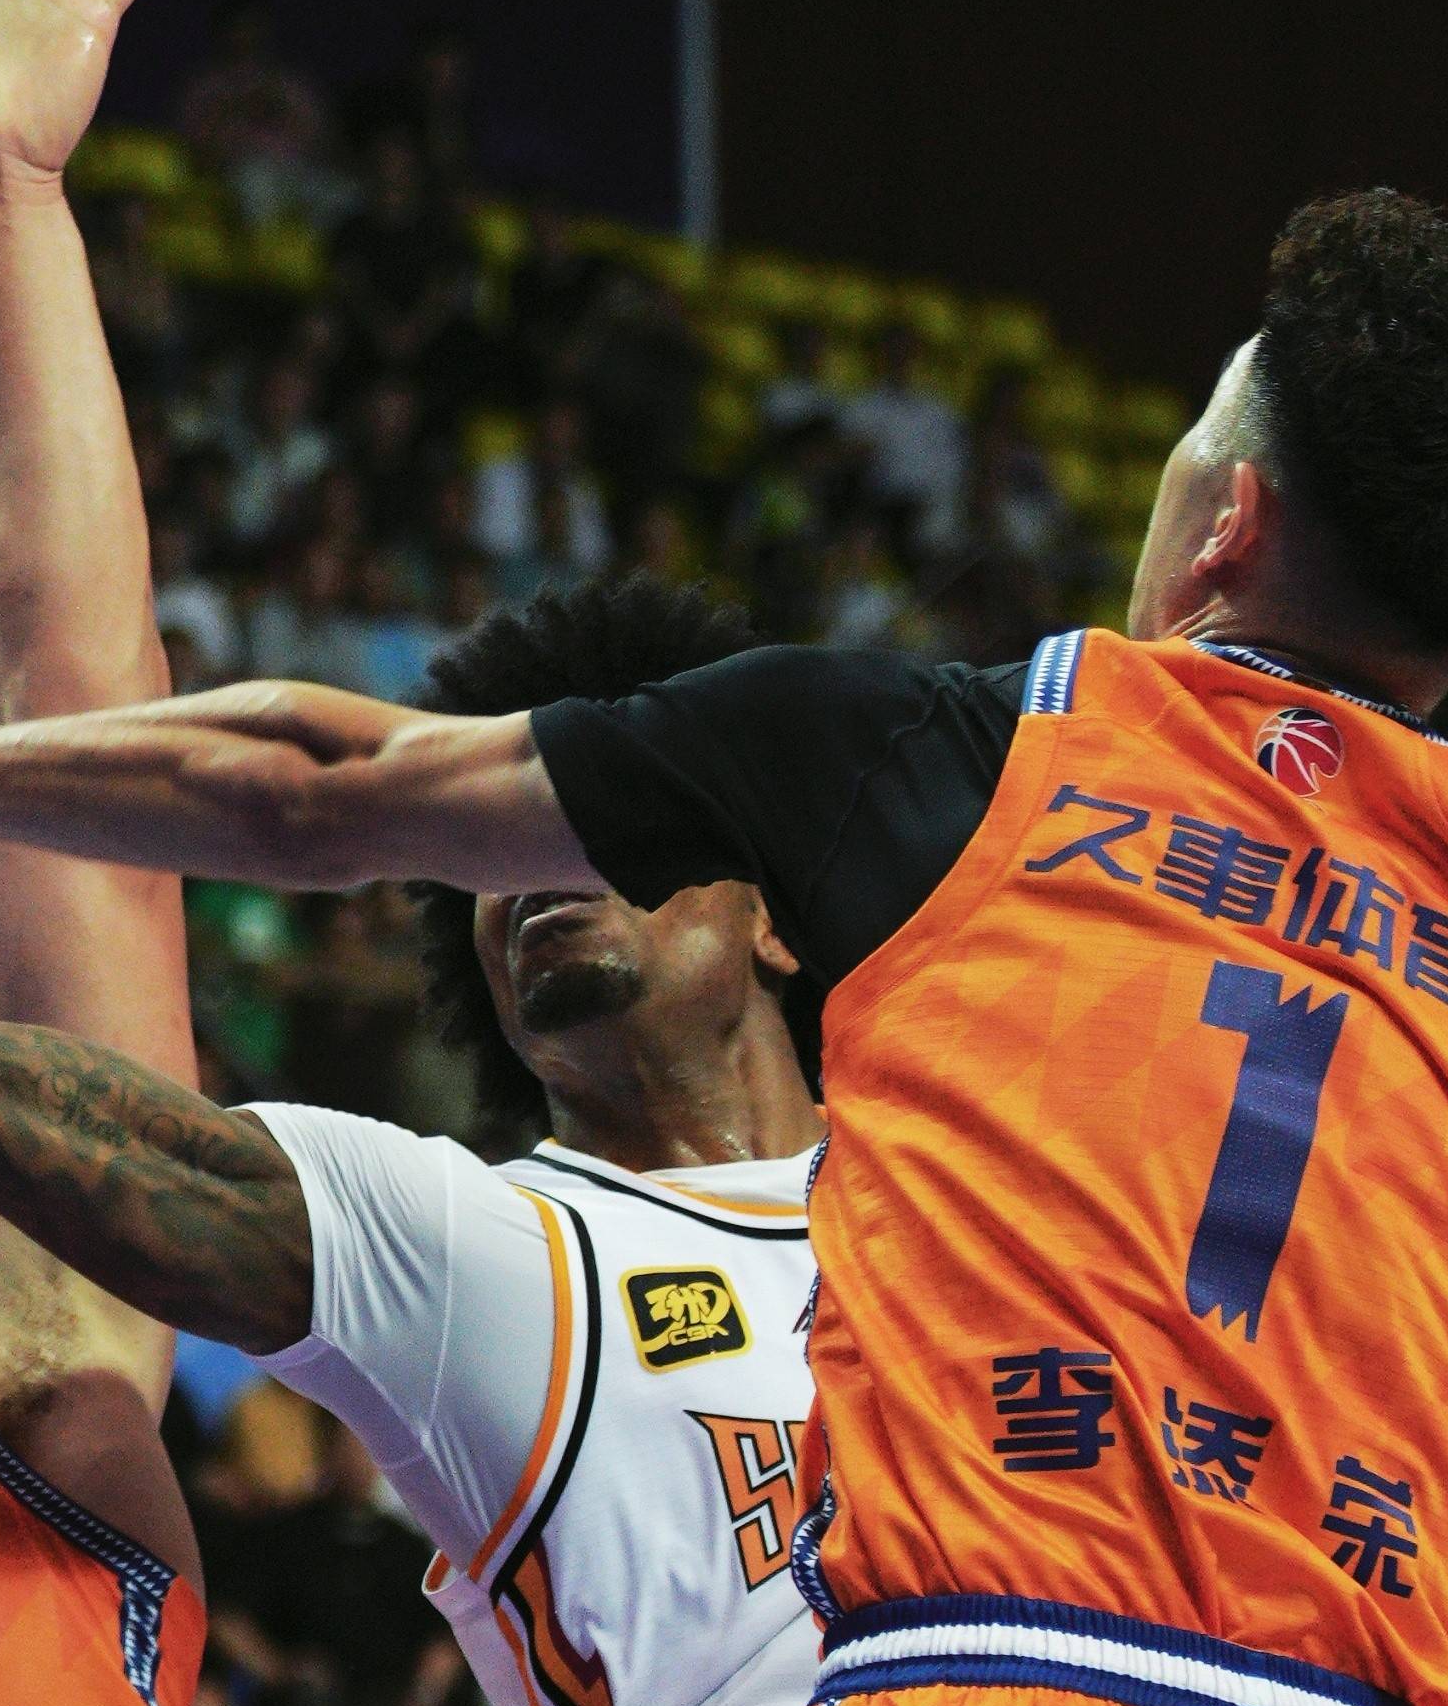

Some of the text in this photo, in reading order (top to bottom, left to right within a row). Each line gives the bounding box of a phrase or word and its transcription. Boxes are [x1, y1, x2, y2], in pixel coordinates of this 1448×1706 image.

[1184, 958, 1351, 1344] 1
[669, 1324, 730, 1346] CBA
[683, 1409, 806, 1594] S
[992, 1346, 1420, 1598] 李添荣
